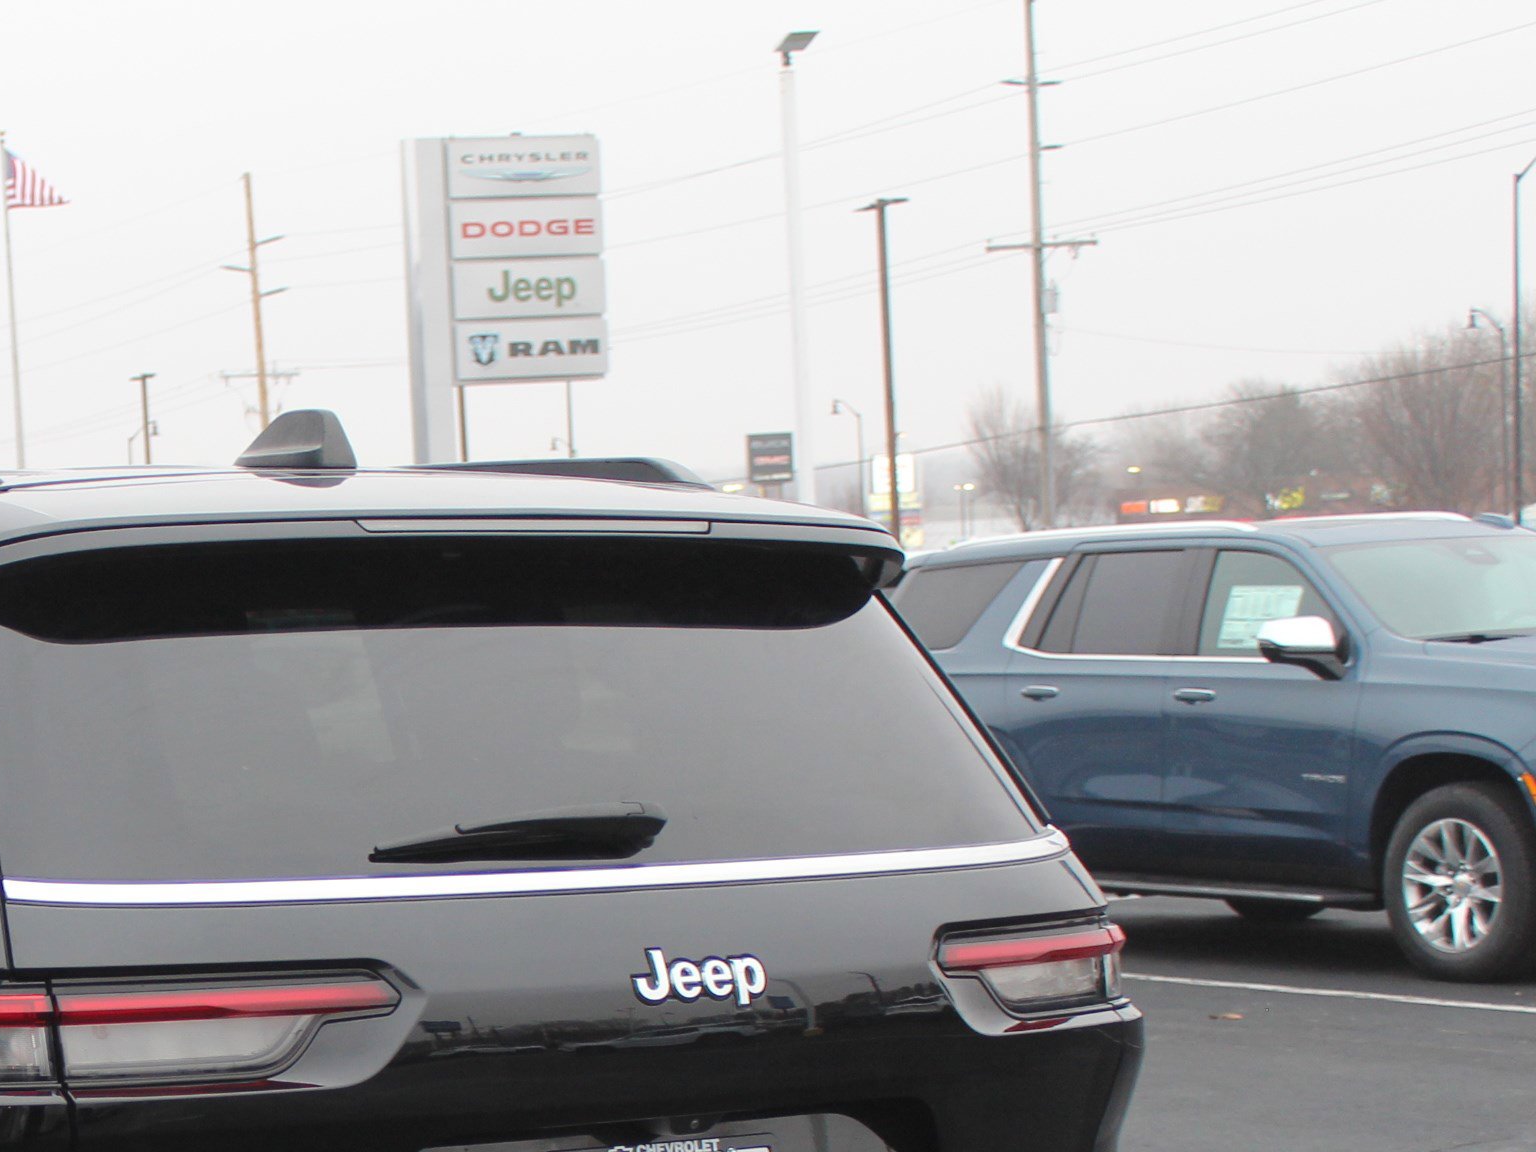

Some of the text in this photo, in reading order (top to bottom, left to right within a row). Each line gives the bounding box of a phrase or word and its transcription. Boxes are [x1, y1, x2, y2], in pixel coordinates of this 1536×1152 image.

[460, 151, 590, 164] CHRYSLER
[461, 219, 595, 239] DODGE
[487, 270, 578, 308] Jeep
[508, 338, 601, 357] RAM
[630, 947, 768, 1006] Jeep
